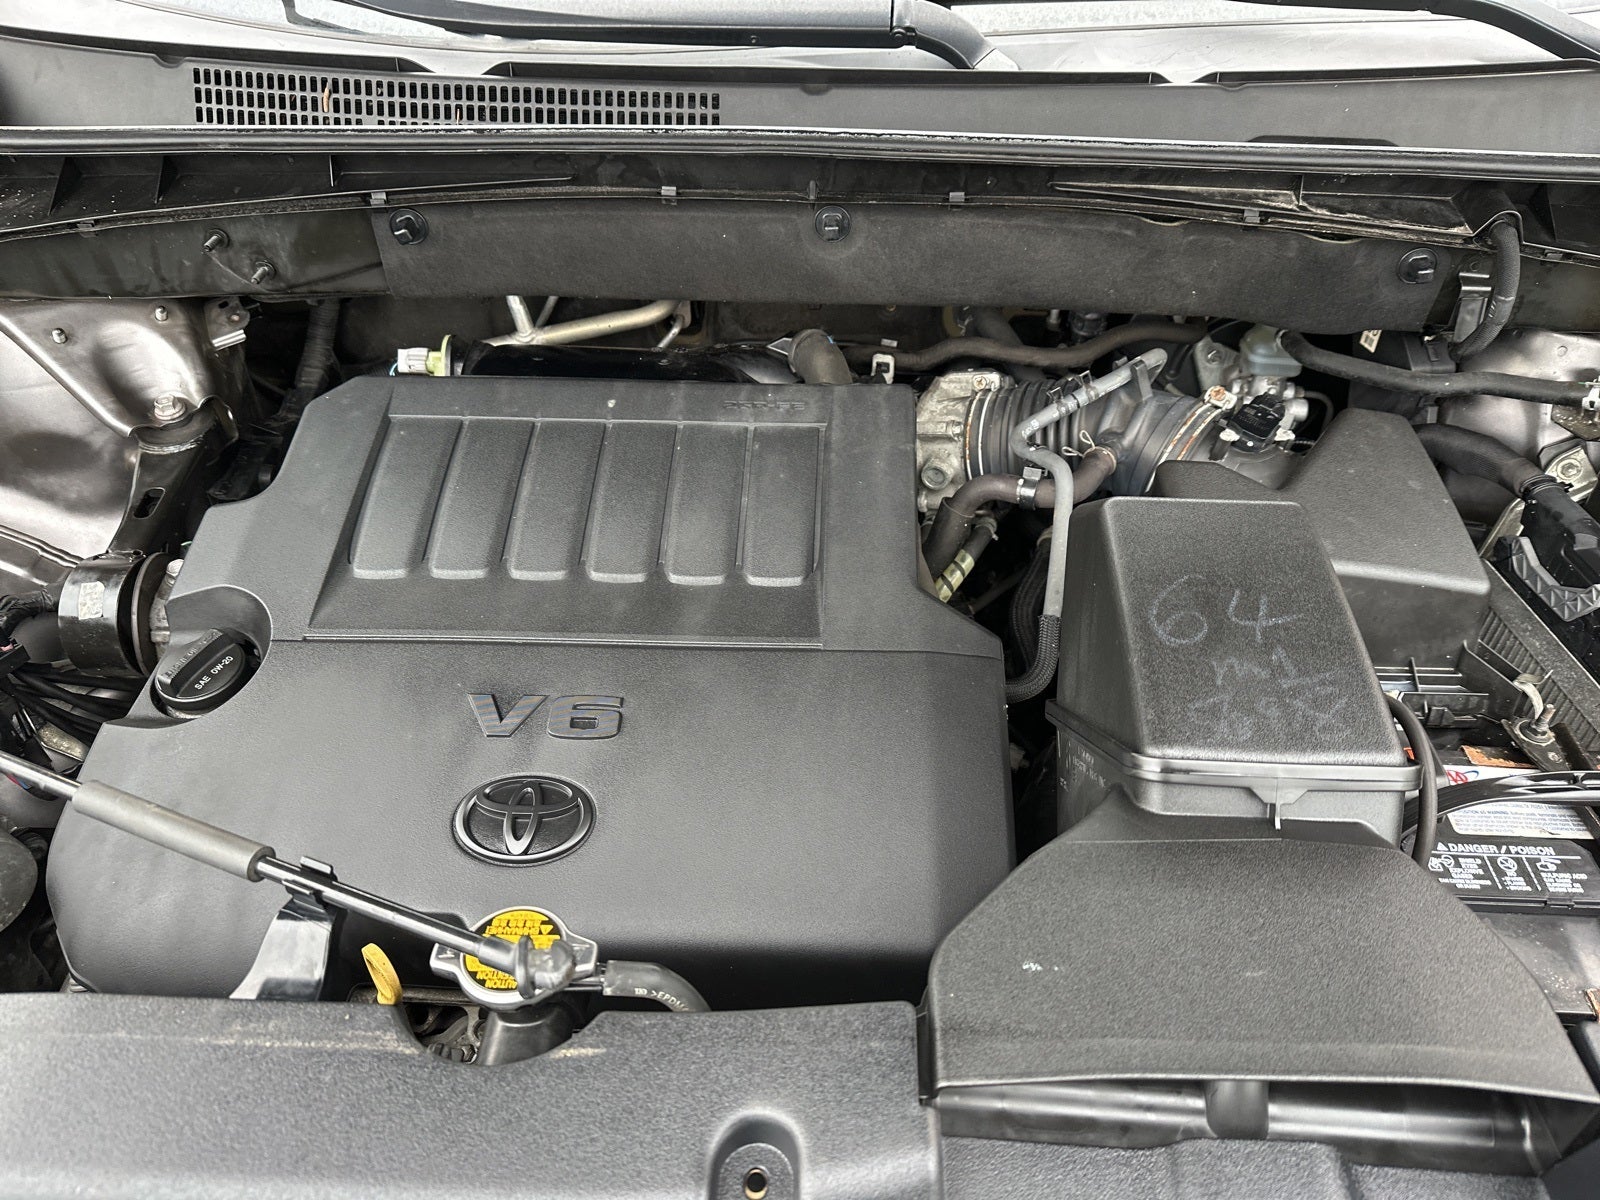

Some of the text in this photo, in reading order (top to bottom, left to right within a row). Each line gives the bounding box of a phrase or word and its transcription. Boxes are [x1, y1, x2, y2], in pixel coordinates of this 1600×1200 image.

[194, 655, 234, 690] SAE 0W-20
[467, 692, 625, 740] V6
[1449, 843, 1498, 854] DANGER
[1511, 845, 1556, 856] POISON
[484, 979, 518, 989] AUTION
